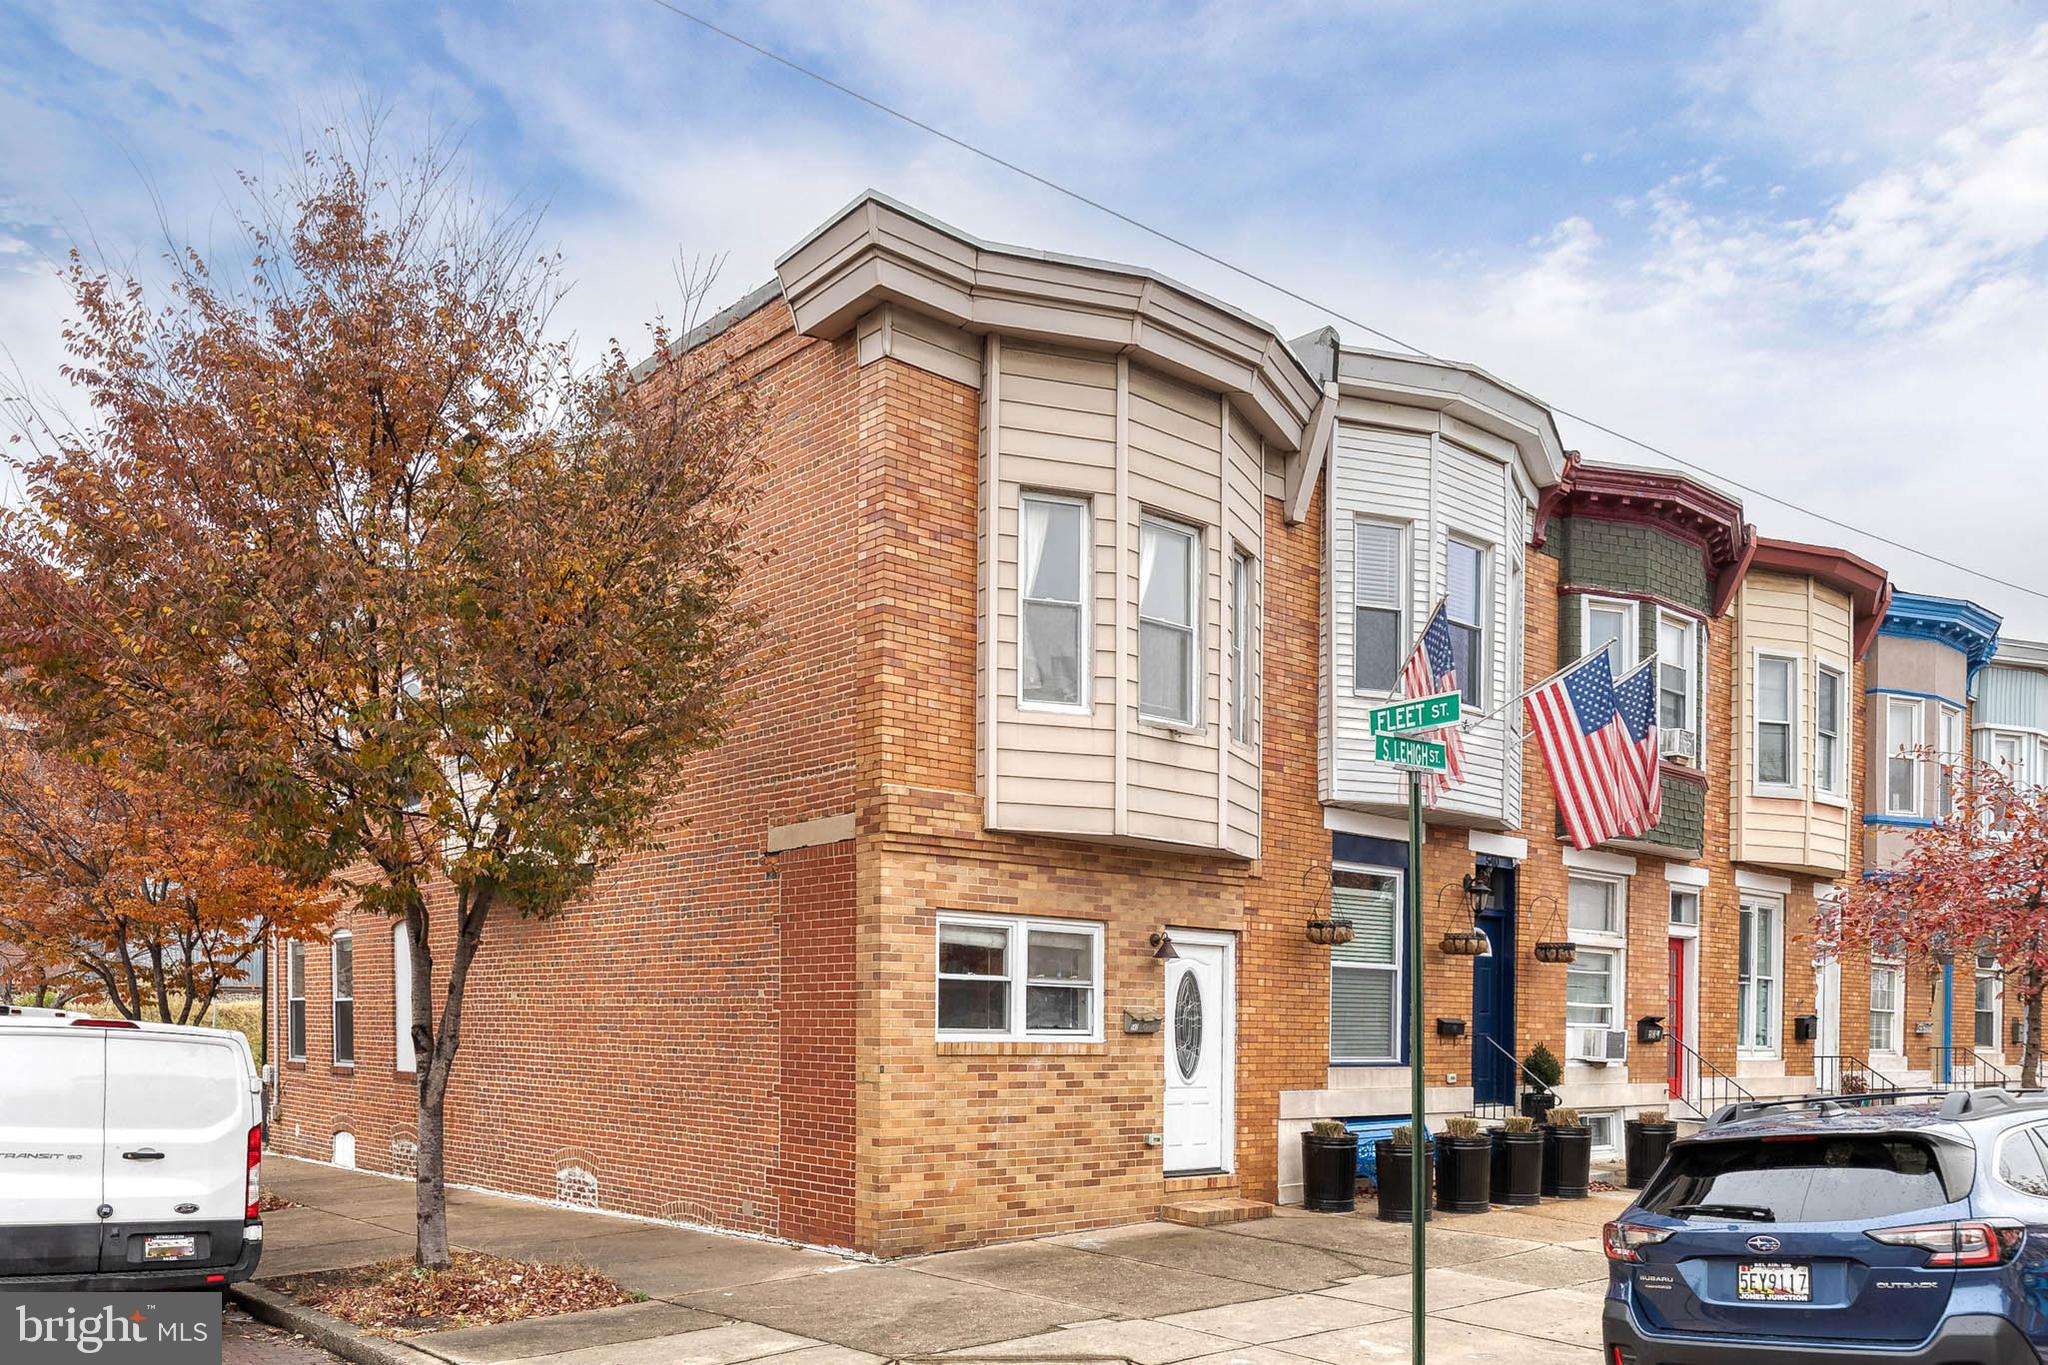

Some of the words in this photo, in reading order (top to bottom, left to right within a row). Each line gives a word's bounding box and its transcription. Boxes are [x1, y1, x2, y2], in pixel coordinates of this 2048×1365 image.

[1376, 703, 1425, 731] FLEET
[1431, 702, 1450, 719] ST.
[1382, 739, 1391, 761] S.
[1394, 741, 1428, 766] LEHIGH
[1429, 749, 1441, 764] ST.
[1640, 1275, 1674, 1283] SUBARU
[1740, 1273, 1807, 1292] 5EY9117
[1739, 1293, 1766, 1301] JONES
[1766, 1293, 1808, 1302] JUNCTION
